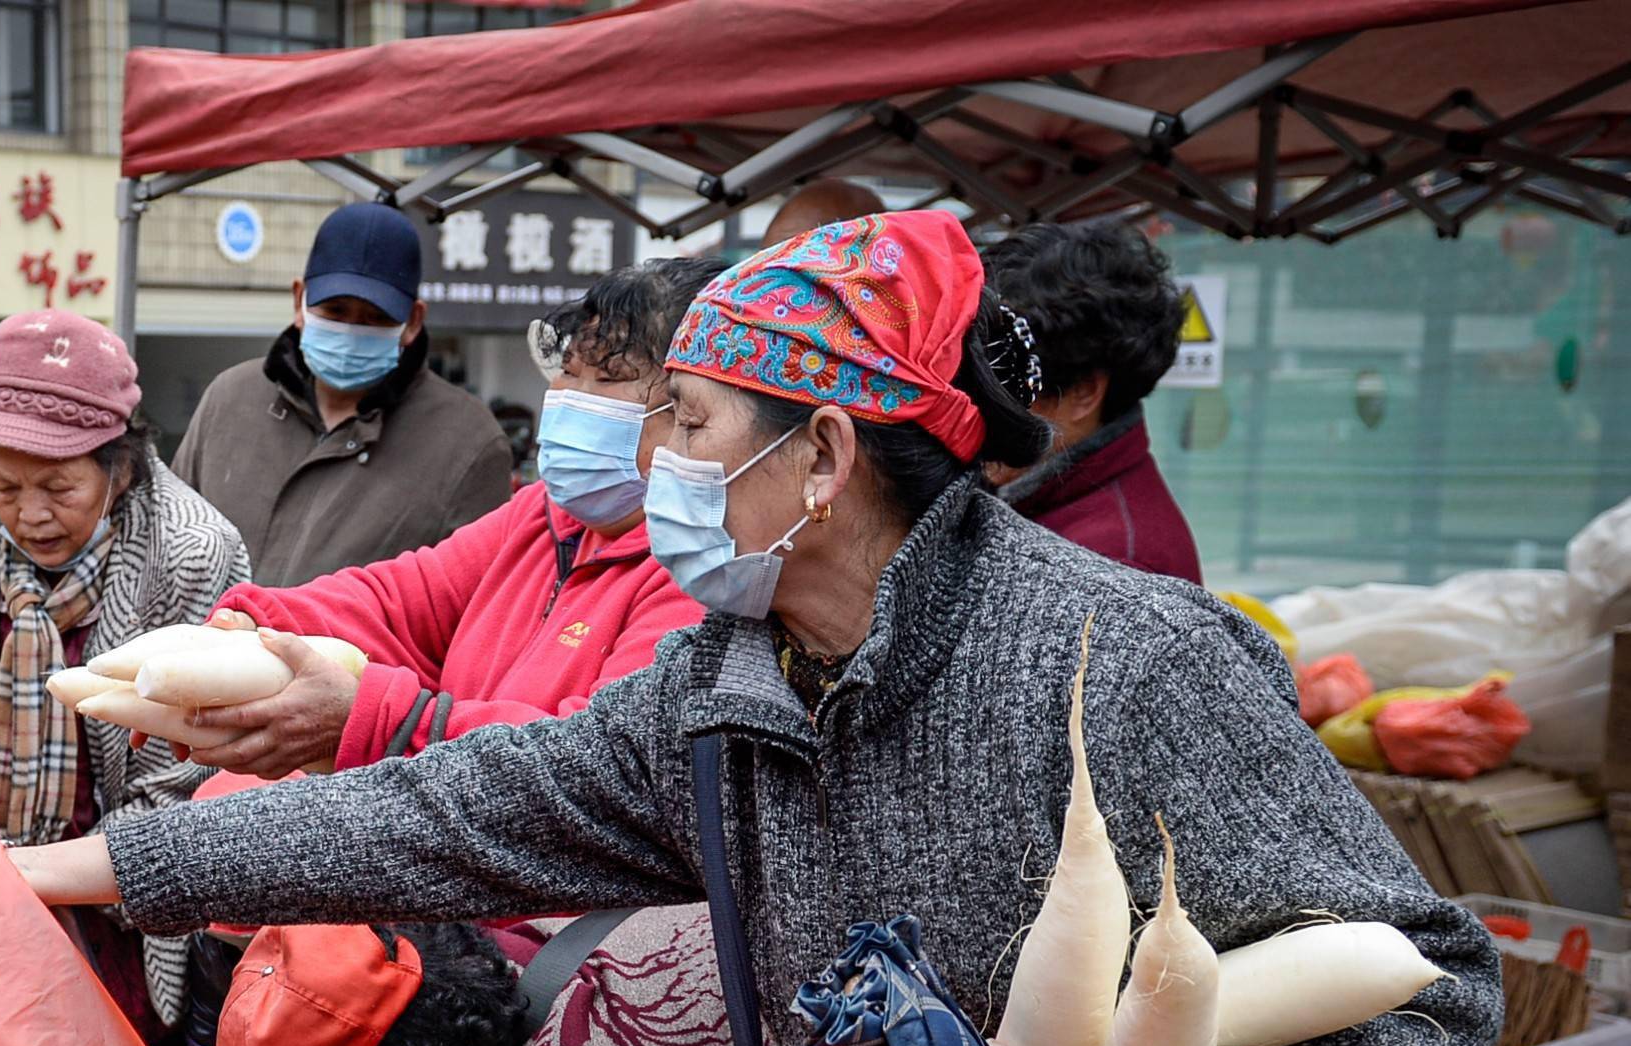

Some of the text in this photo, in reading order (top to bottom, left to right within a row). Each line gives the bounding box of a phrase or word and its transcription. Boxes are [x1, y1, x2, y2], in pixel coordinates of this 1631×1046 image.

[439, 209, 614, 274] 橄榄酒
[19, 251, 107, 308] 饰品
